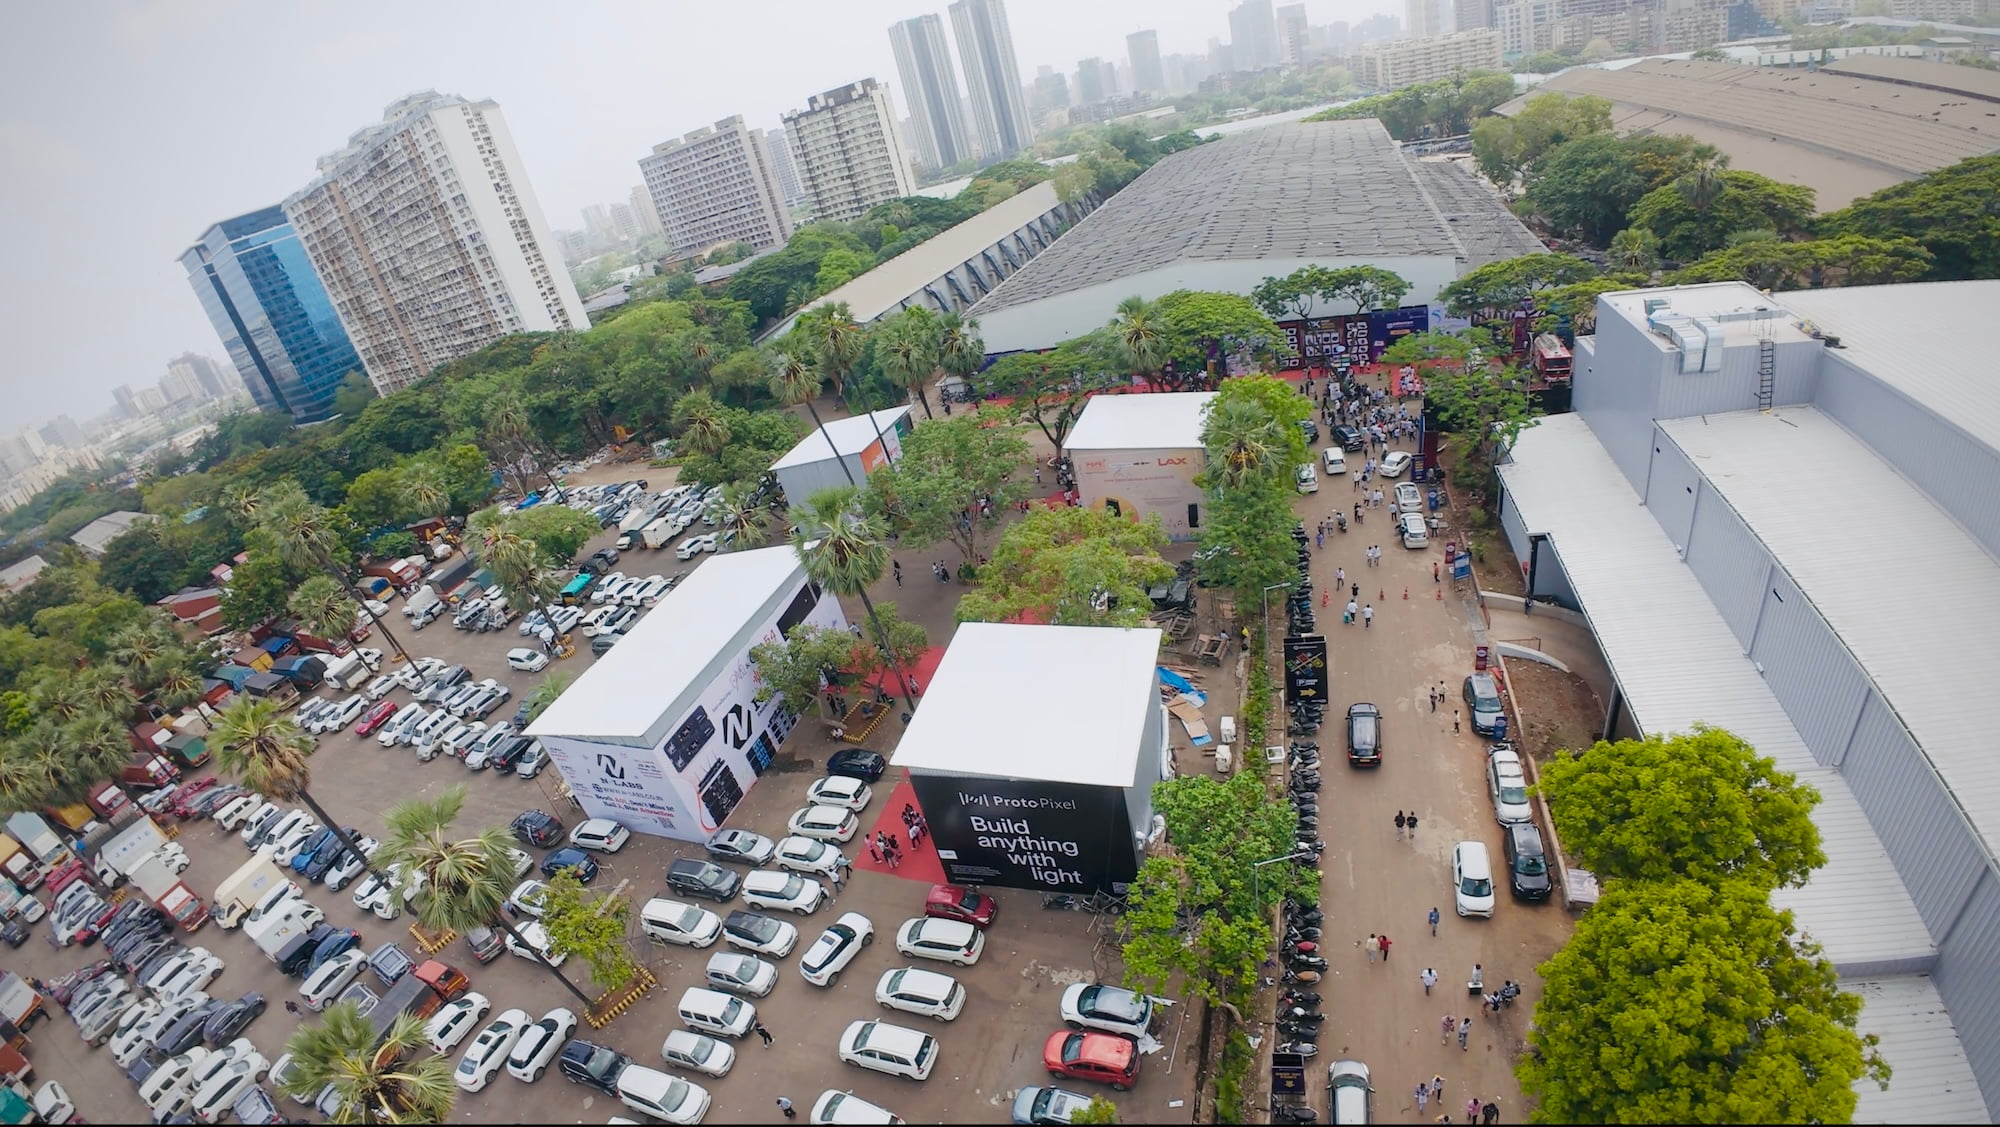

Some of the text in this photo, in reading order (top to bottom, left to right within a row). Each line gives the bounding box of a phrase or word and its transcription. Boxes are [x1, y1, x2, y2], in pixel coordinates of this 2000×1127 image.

[1158, 457, 1188, 466] LAX
[993, 796, 1076, 810] ProtoPixel
[970, 816, 1030, 835] Build
[978, 836, 1079, 856] anything
[1007, 852, 1056, 867] with
[1031, 867, 1083, 885] light
